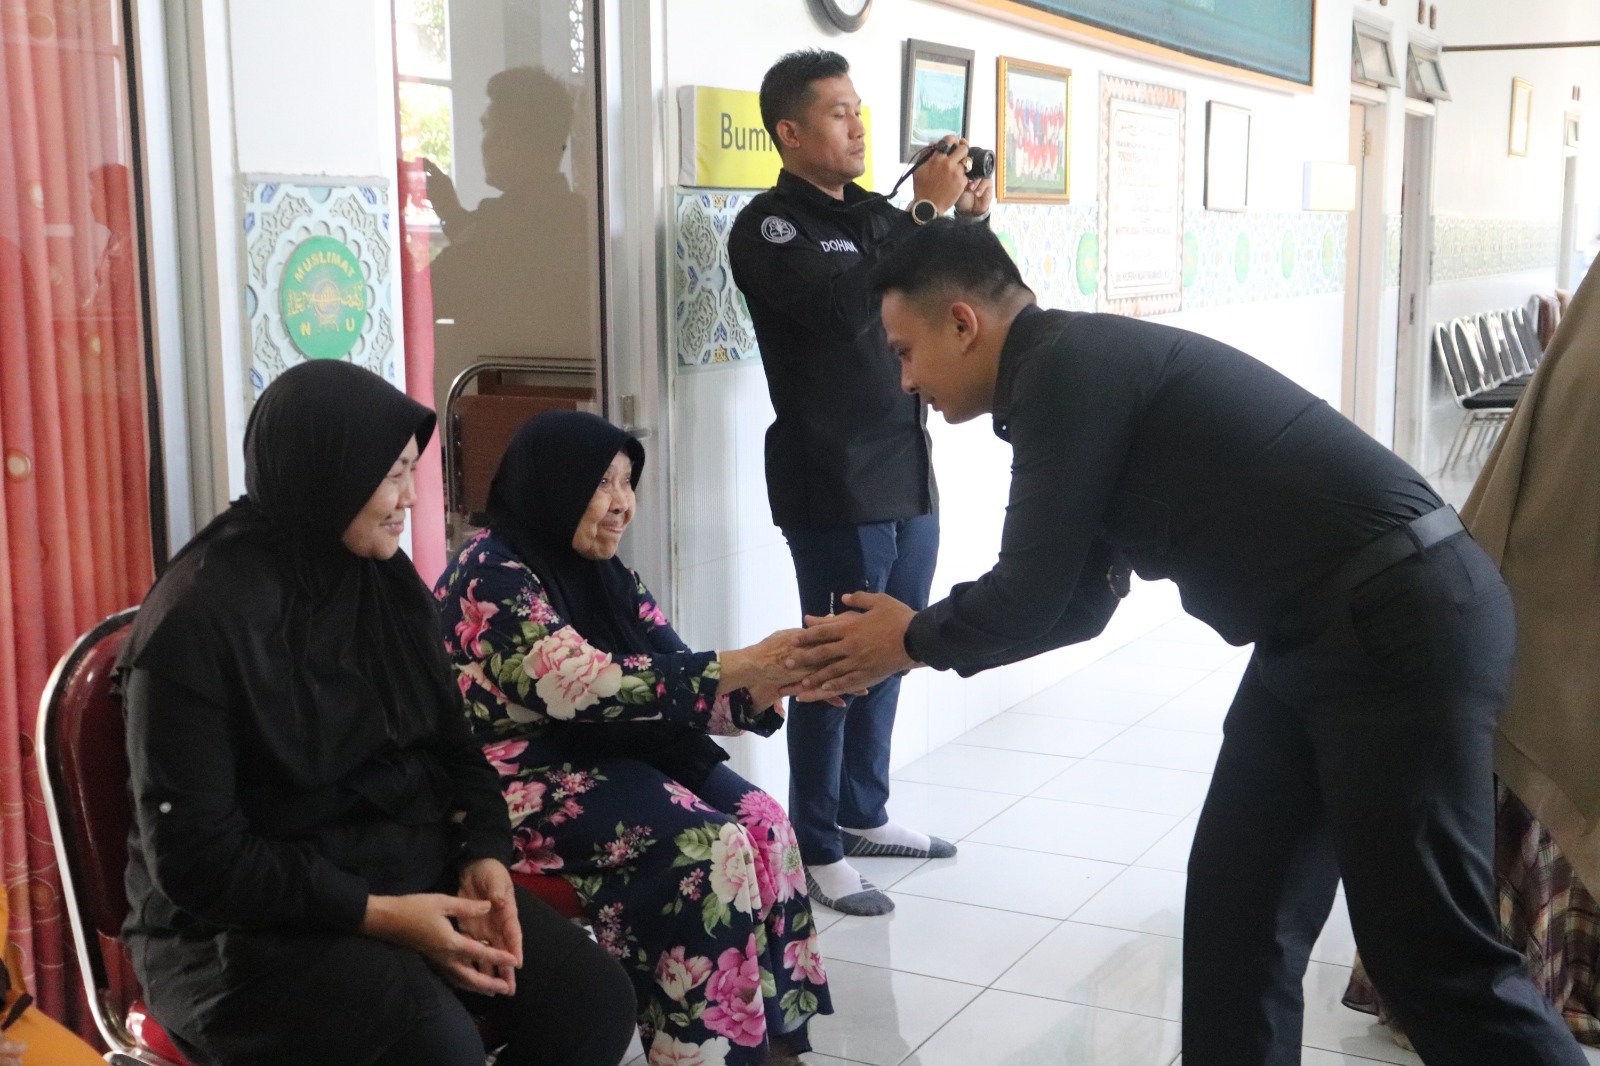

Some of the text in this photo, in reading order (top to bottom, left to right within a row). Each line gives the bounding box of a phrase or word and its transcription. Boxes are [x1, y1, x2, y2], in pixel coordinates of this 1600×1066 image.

[294, 251, 355, 283] MUSLIMAT
[301, 317, 356, 336] N U
